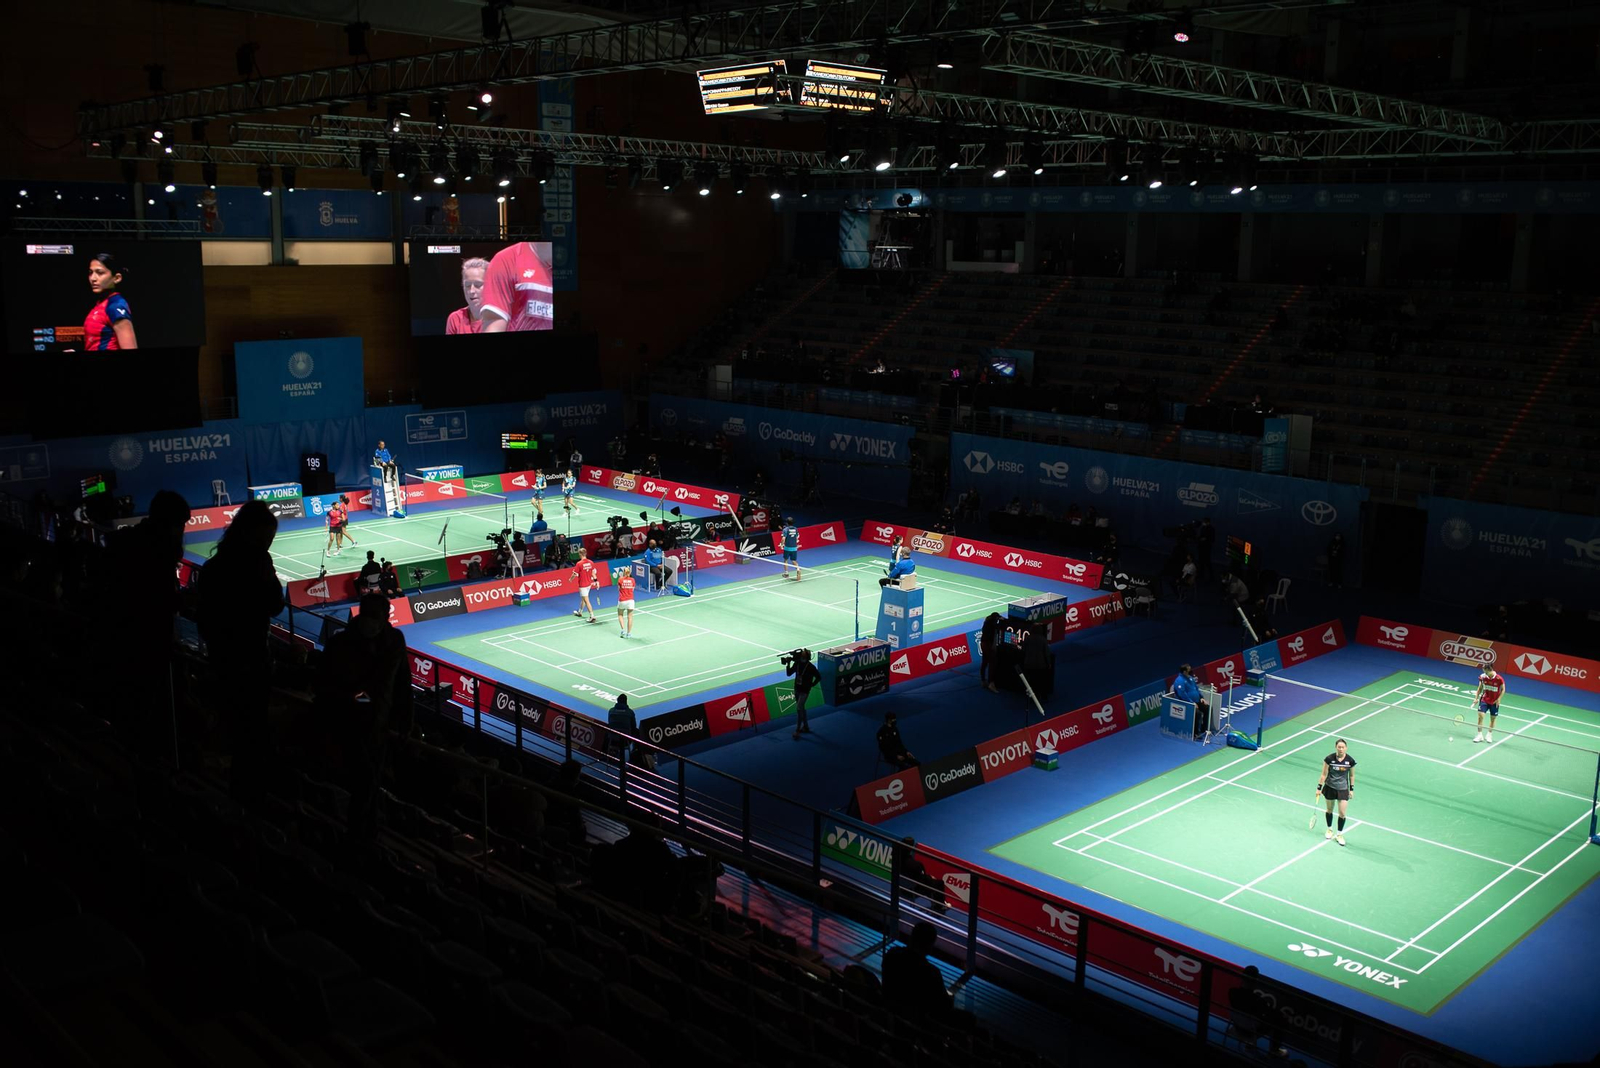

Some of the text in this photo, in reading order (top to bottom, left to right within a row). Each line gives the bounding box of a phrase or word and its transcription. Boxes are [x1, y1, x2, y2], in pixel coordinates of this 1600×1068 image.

[282, 382, 322, 392] HUELVA'21
[290, 389, 316, 397] ESPAÑA
[551, 403, 607, 418] HUELVA'21
[562, 416, 598, 427] ESPAÑA
[149, 434, 231, 453] HUELVA'21
[774, 427, 816, 447] GoDaddy
[854, 437, 896, 459] YONEX
[165, 449, 218, 464] ESPAÑA
[306, 457, 320, 469] 195
[438, 469, 461, 479] YONEX
[997, 461, 1024, 474] HSBC
[1113, 477, 1160, 493] HUELVA'21
[272, 487, 299, 498] YONEX
[409, 490, 425, 498] HSBC
[688, 492, 701, 500] HSBC
[1120, 488, 1150, 499] ESPAÑA
[1479, 530, 1548, 550] HUELVA'21
[976, 549, 993, 559] HSBC
[1489, 544, 1532, 559] ESPAÑA
[1025, 559, 1043, 569] HSBC
[543, 579, 562, 590] HSBC
[466, 586, 514, 605] TOYOTA
[427, 597, 462, 611] GoDaddy
[1042, 602, 1064, 617] YONEX
[1089, 600, 1123, 618] TOYOTA
[891, 621, 896, 631] 1
[857, 647, 887, 667] YONEX
[949, 645, 967, 657] HSBC
[892, 662, 907, 671] BWF
[1554, 664, 1588, 680] HSBC
[1413, 678, 1460, 692] YONEX
[664, 718, 704, 738] GoDaddy
[1059, 725, 1080, 741] HSBC
[981, 740, 1032, 771] TOYOTA
[939, 763, 976, 784] GoDaddy
[879, 802, 909, 816] TotalEnergies
[1332, 955, 1409, 990] YONEX
